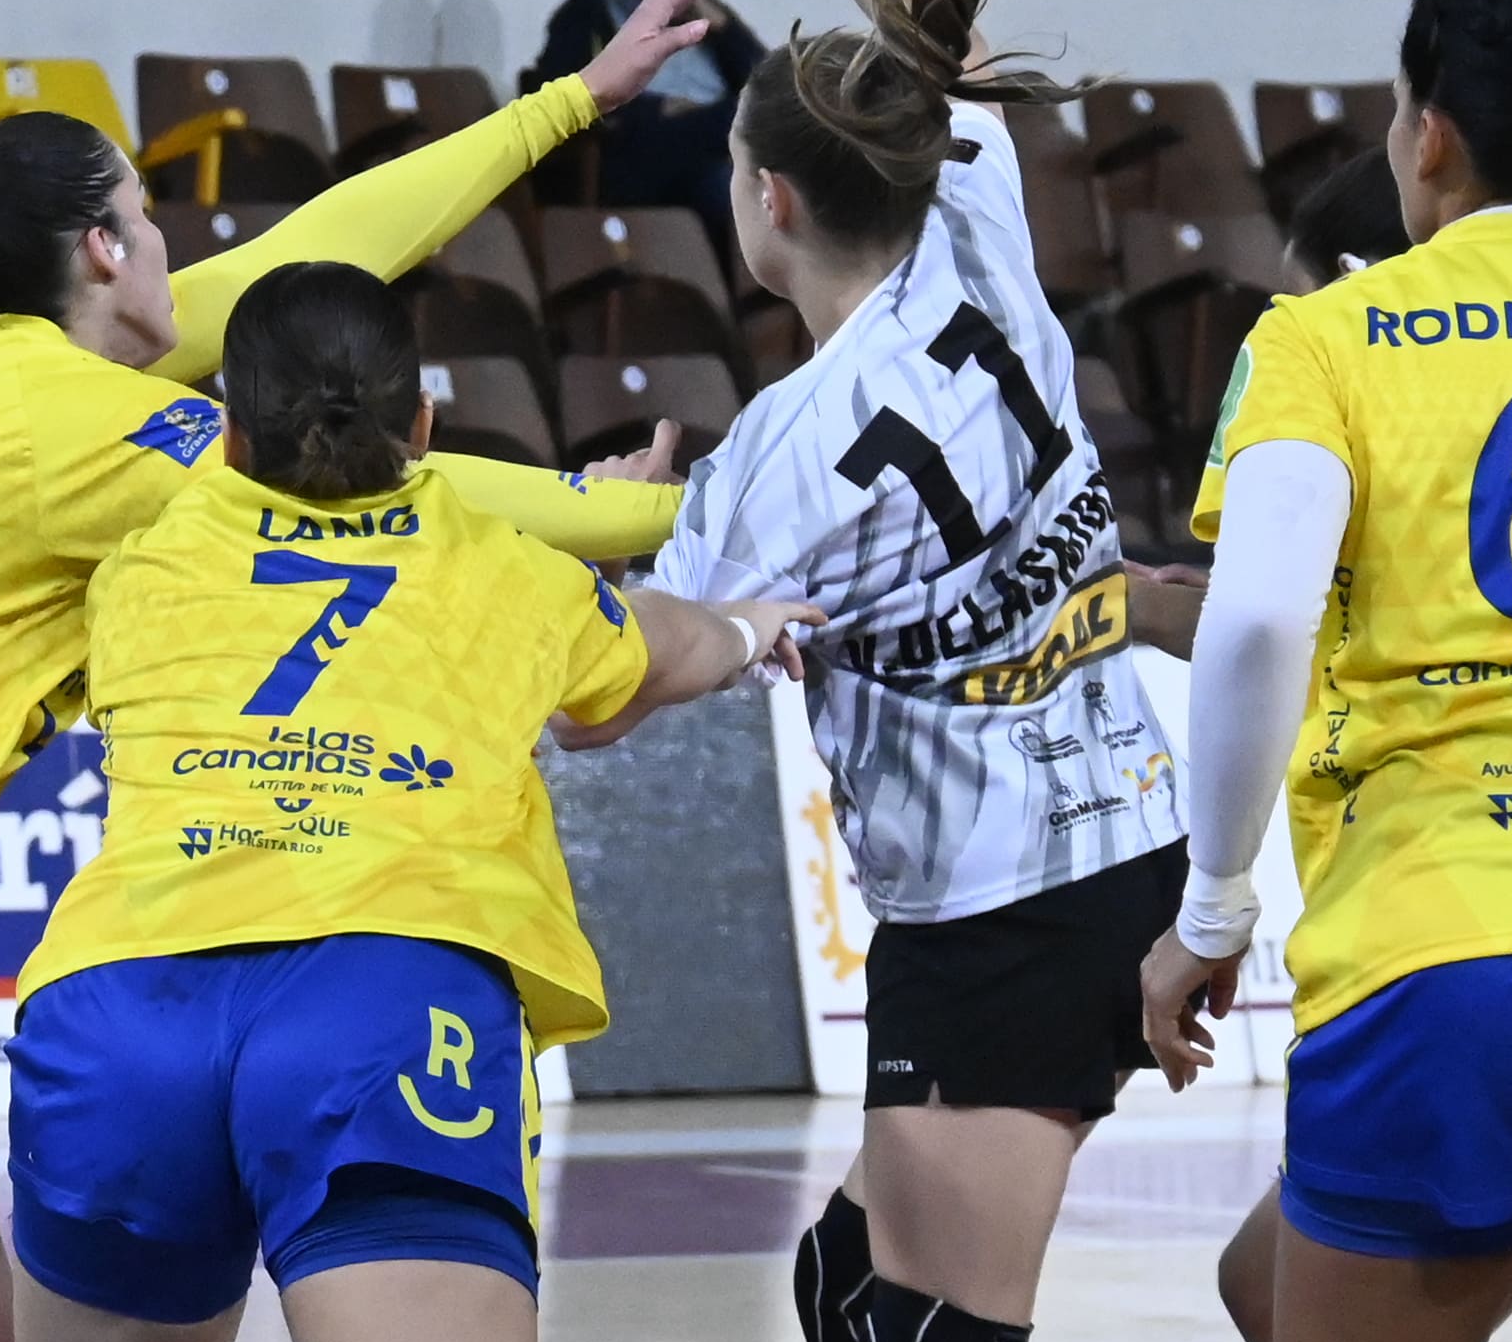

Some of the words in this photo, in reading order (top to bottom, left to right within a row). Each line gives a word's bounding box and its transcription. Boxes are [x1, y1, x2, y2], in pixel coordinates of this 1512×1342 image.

[257, 503, 420, 542] LANG
[239, 549, 398, 717] 7
[428, 1007, 477, 1089] R
